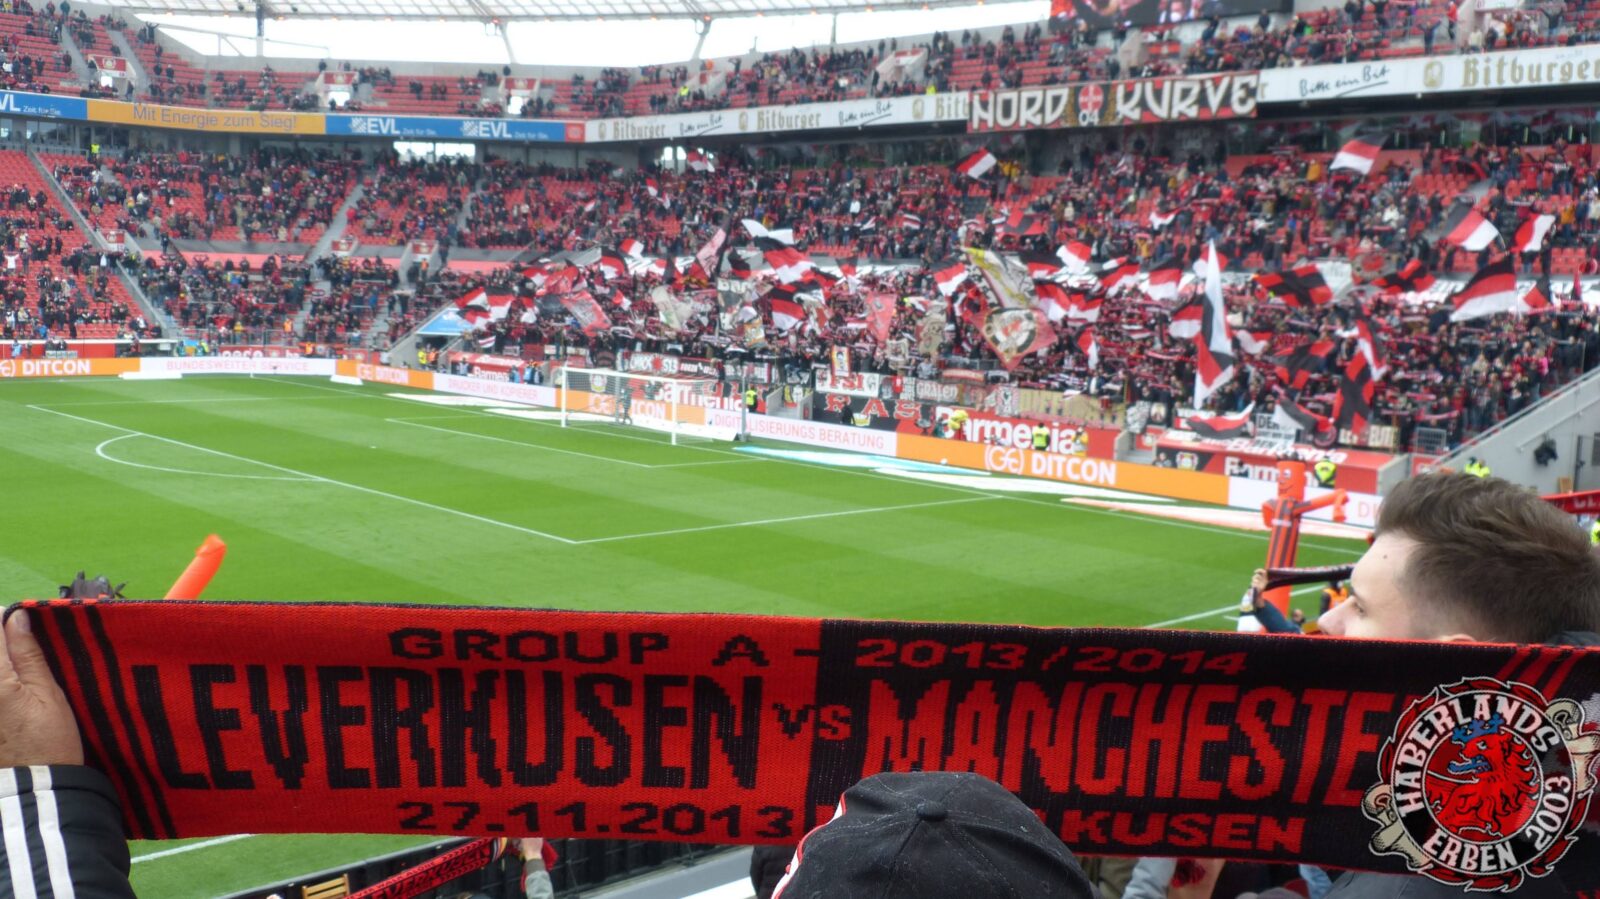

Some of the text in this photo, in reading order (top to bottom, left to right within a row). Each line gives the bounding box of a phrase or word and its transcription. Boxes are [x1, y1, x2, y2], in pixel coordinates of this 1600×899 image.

[972, 87, 1069, 130] NORD
[1079, 110, 1099, 127] 04
[1116, 74, 1258, 120] KURVE
[133, 107, 297, 131] Mit Energie zum Sieg!
[368, 118, 400, 134] EVL
[479, 121, 512, 138] EVL
[613, 121, 665, 139] Bitburger
[757, 110, 821, 130] Bitburger
[22, 360, 91, 376] DITCON
[819, 429, 884, 449] BERATUNG
[936, 405, 1077, 455] Brmeia
[1031, 452, 1117, 485] DITCON
[387, 627, 670, 665] GROUP
[712, 634, 770, 667] A
[131, 664, 763, 790] LEVERKUSEN
[862, 679, 1420, 807] MANCHESTE
[396, 801, 1306, 854] 27.11.2013 KUSEN
